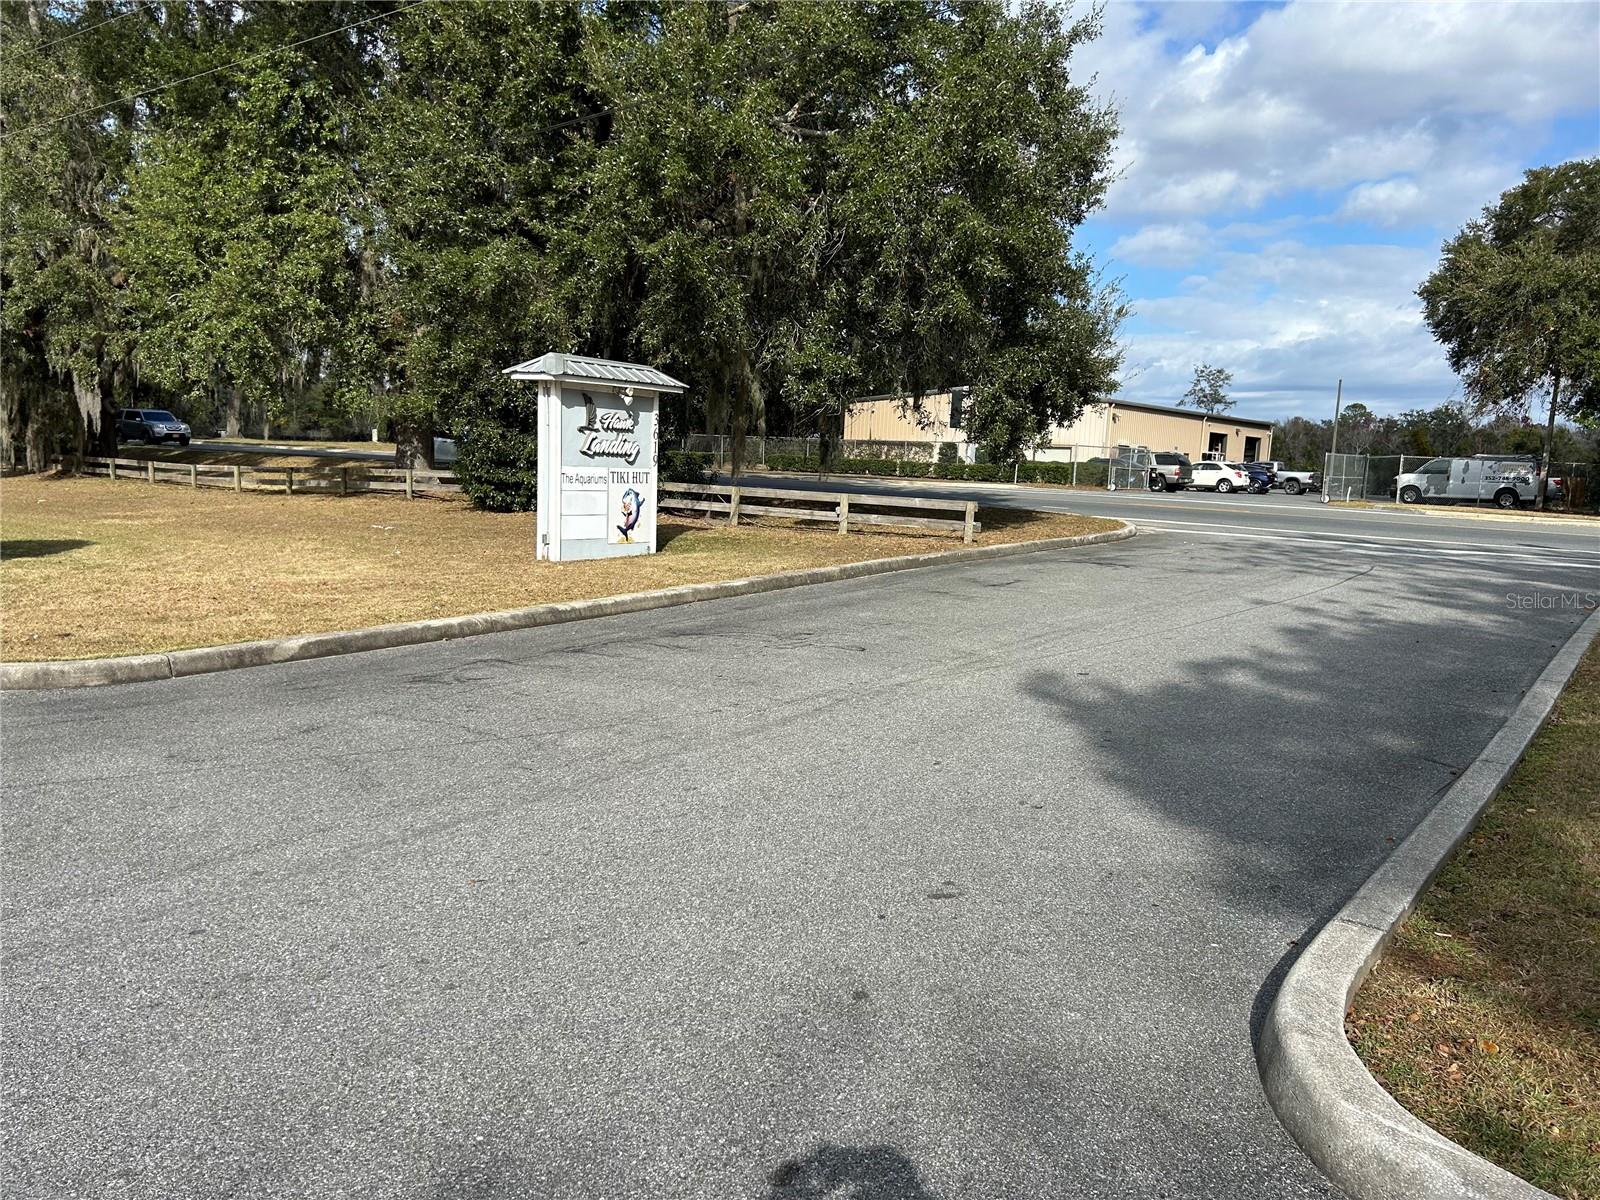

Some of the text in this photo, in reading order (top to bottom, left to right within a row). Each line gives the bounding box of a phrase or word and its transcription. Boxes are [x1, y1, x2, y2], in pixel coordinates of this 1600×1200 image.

[579, 430, 640, 466] Landing
[561, 472, 608, 487] The Aquariums
[610, 471, 650, 484] TIKI HUT
